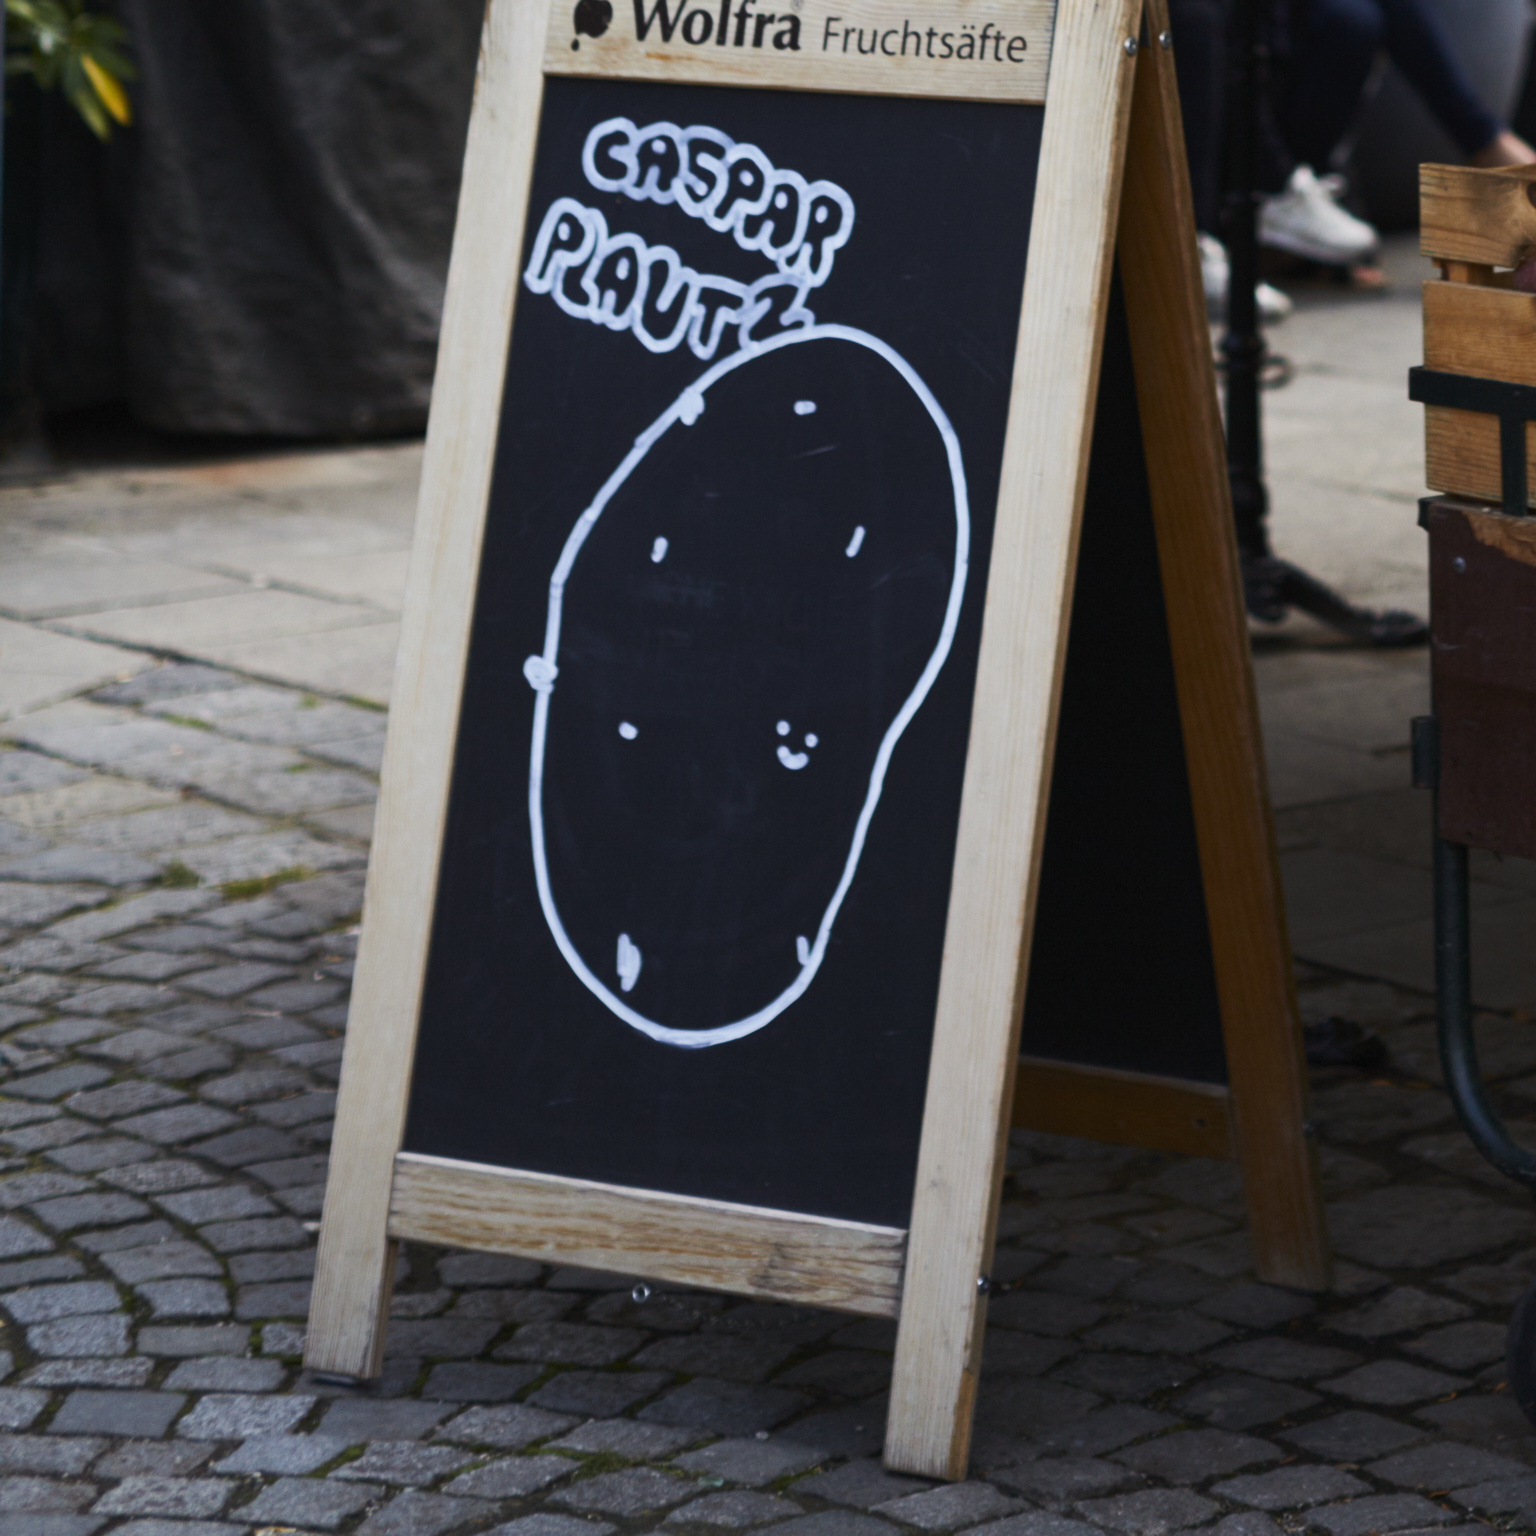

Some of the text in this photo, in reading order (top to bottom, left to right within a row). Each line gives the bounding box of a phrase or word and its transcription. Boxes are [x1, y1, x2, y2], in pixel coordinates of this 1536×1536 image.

[820, 16, 1028, 63] Fruchtsäfte
[523, 197, 815, 360] PLAUTZ
[582, 116, 855, 288] CASPAR
